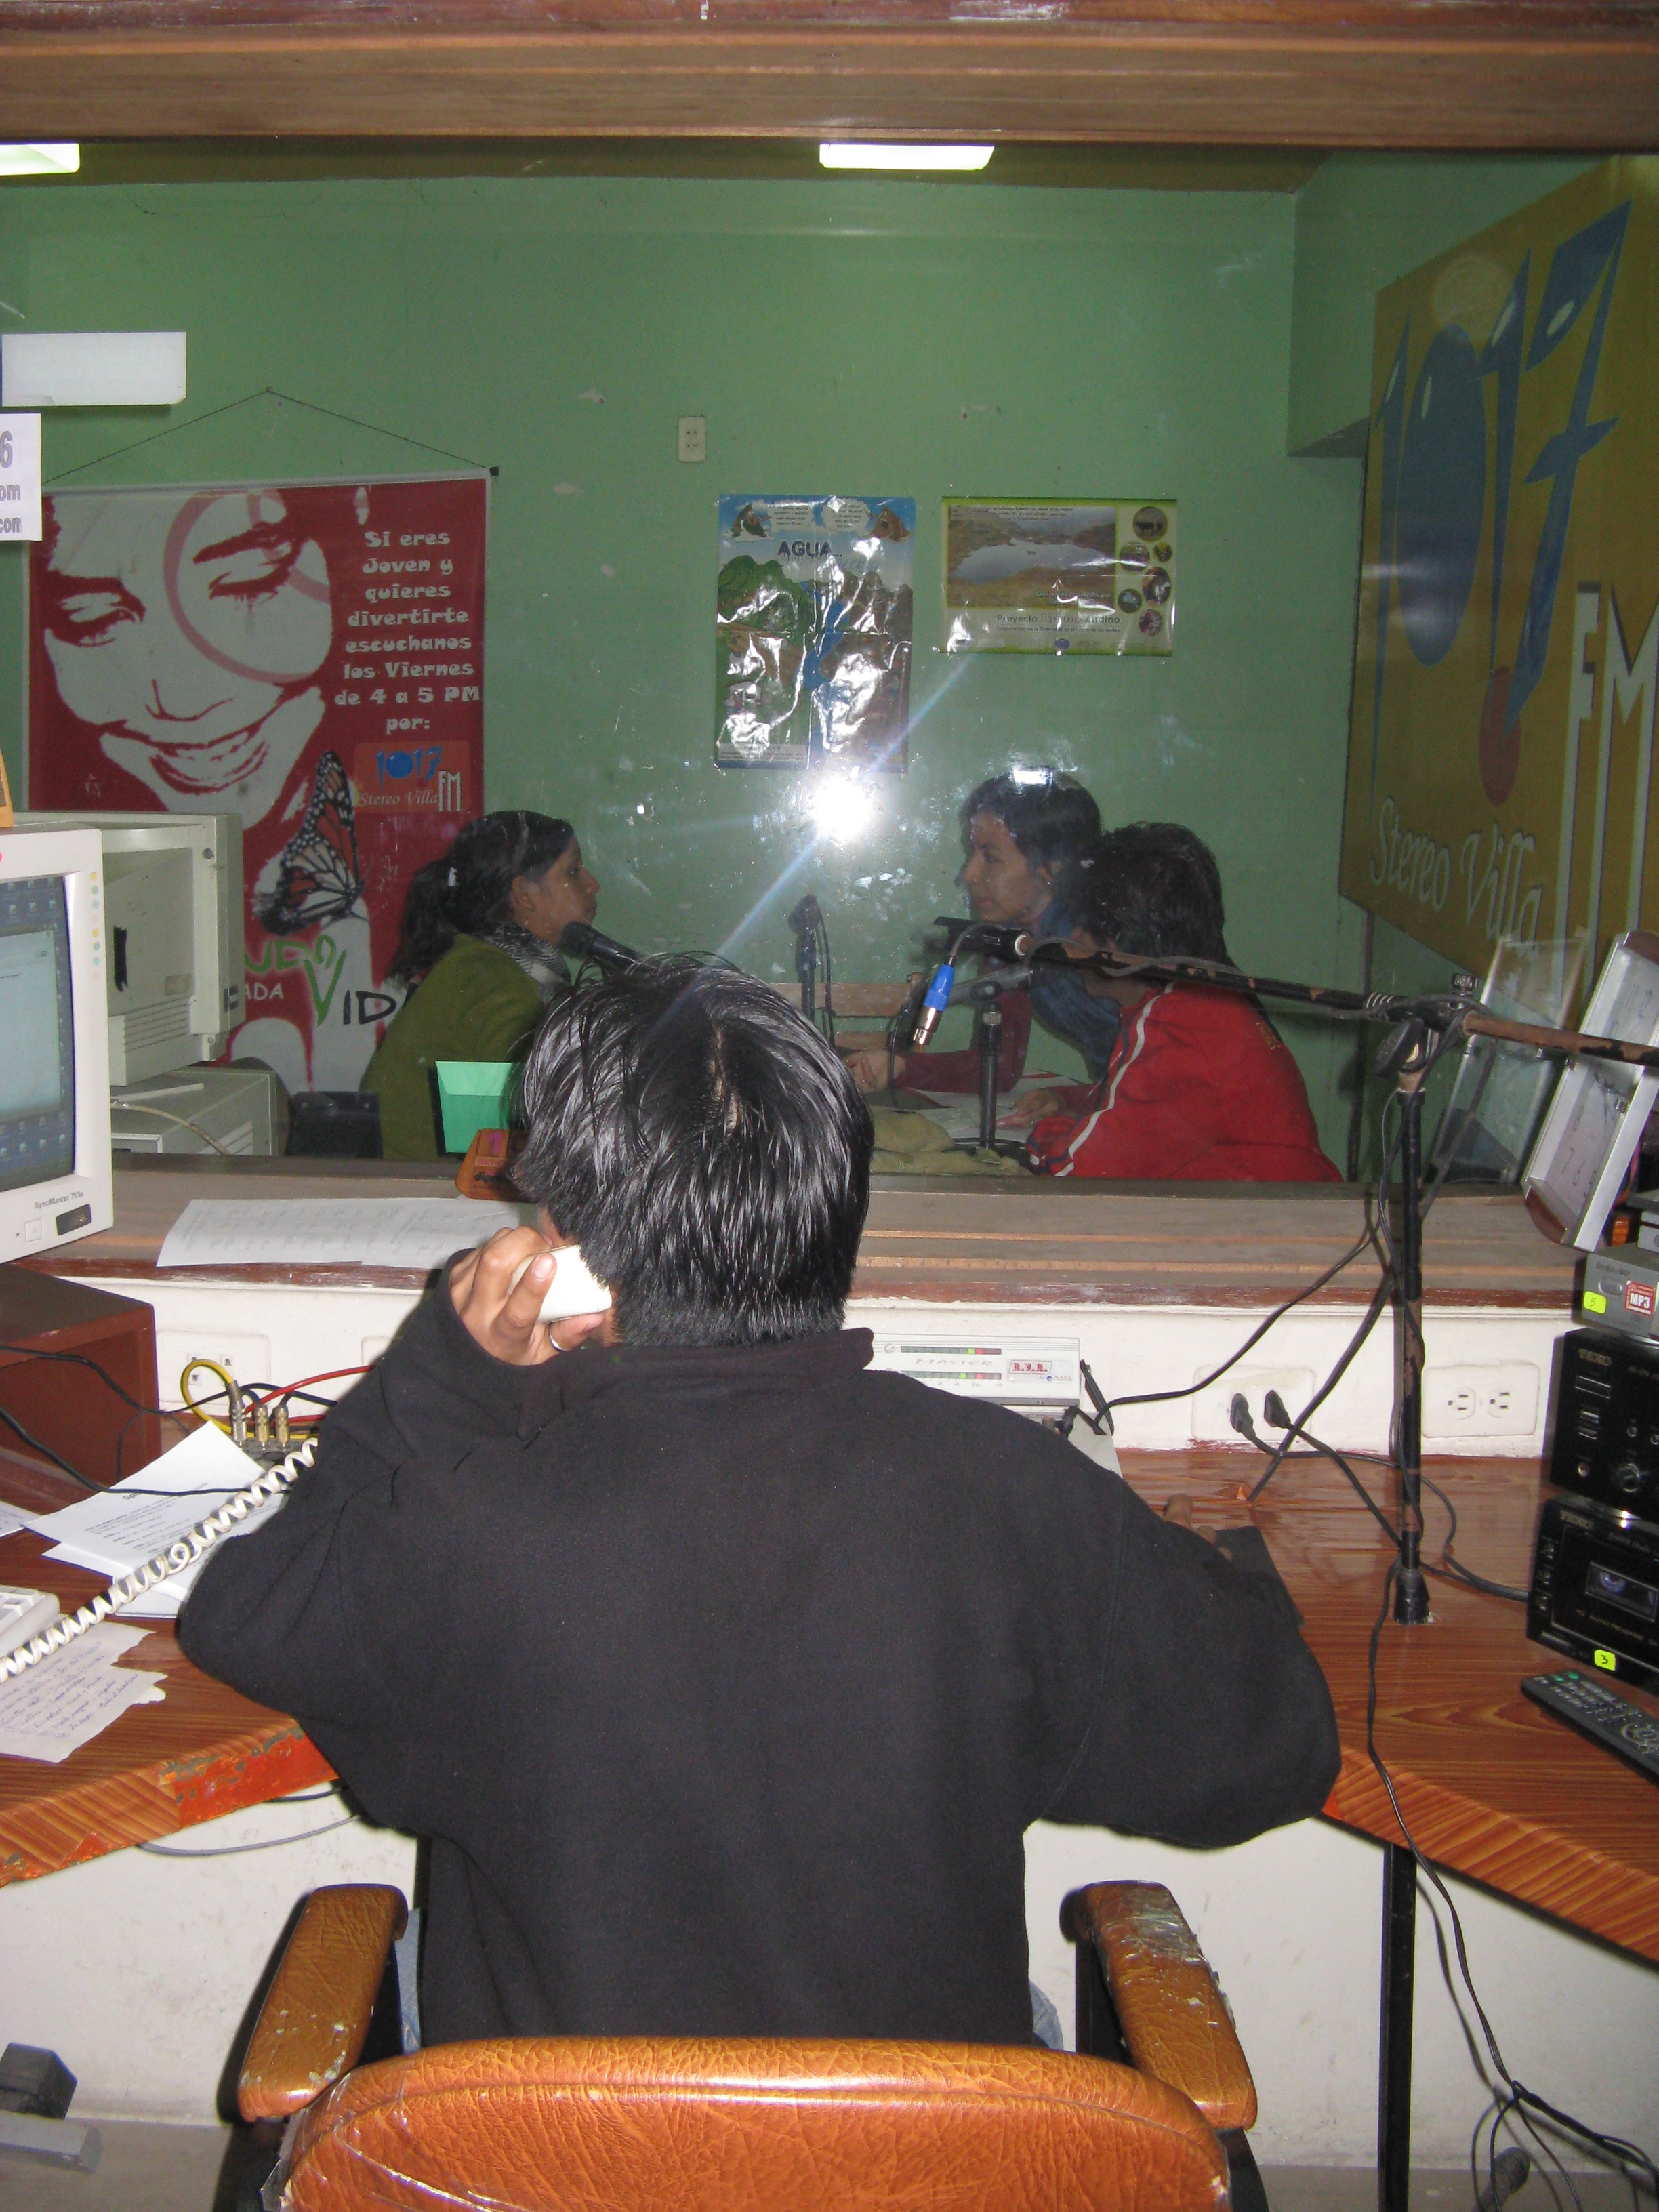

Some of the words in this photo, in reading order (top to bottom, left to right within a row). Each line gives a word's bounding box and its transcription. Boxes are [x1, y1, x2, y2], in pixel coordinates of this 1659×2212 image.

[0, 430, 13, 469] 6
[364, 531, 390, 548] Si
[400, 532, 451, 546] eres
[362, 557, 431, 574] Joven
[439, 558, 453, 575] y
[365, 583, 451, 604] quieres
[347, 607, 469, 627] divertirte
[996, 614, 1038, 624] Proyecto
[1084, 614, 1121, 624] Andino
[345, 634, 472, 653] escuchanos
[343, 663, 376, 679] los
[384, 661, 474, 678] Viernes
[334, 689, 361, 705] de
[369, 688, 387, 705] 4
[395, 691, 409, 704] a
[417, 687, 434, 703] 5
[444, 685, 480, 703] PM
[386, 717, 430, 735] por:
[359, 792, 401, 807] Stereo
[404, 788, 438, 804] Villa
[438, 769, 462, 812] FM
[1370, 795, 1452, 913] Stereo
[35, 1195, 70, 1210] SyncMaster
[1589, 1297, 1597, 1307] 5
[1629, 1292, 1651, 1309] MP3
[1600, 1654, 1609, 1665] 3
